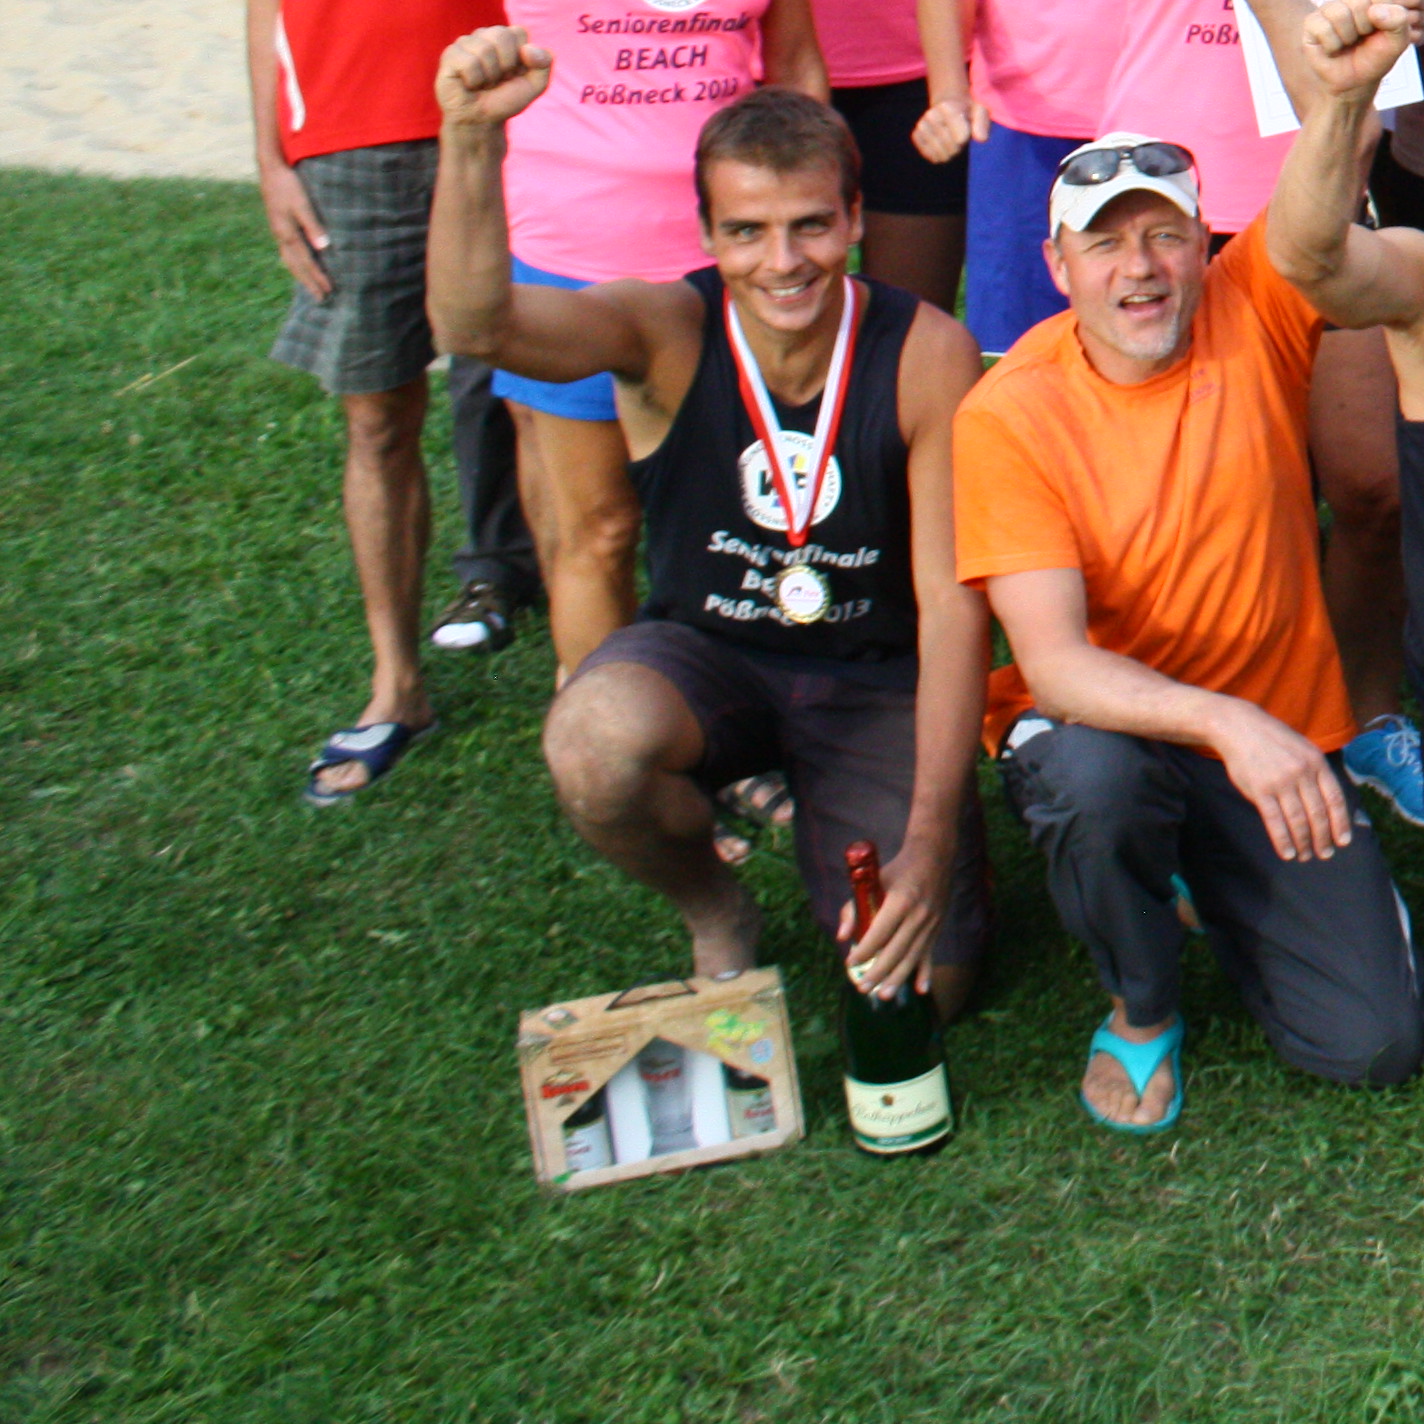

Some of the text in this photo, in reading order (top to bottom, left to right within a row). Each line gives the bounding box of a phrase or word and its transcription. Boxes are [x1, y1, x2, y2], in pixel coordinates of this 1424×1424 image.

[613, 44, 708, 70] BEACH
[579, 80, 688, 105] Pößneck
[824, 598, 873, 623] 013
